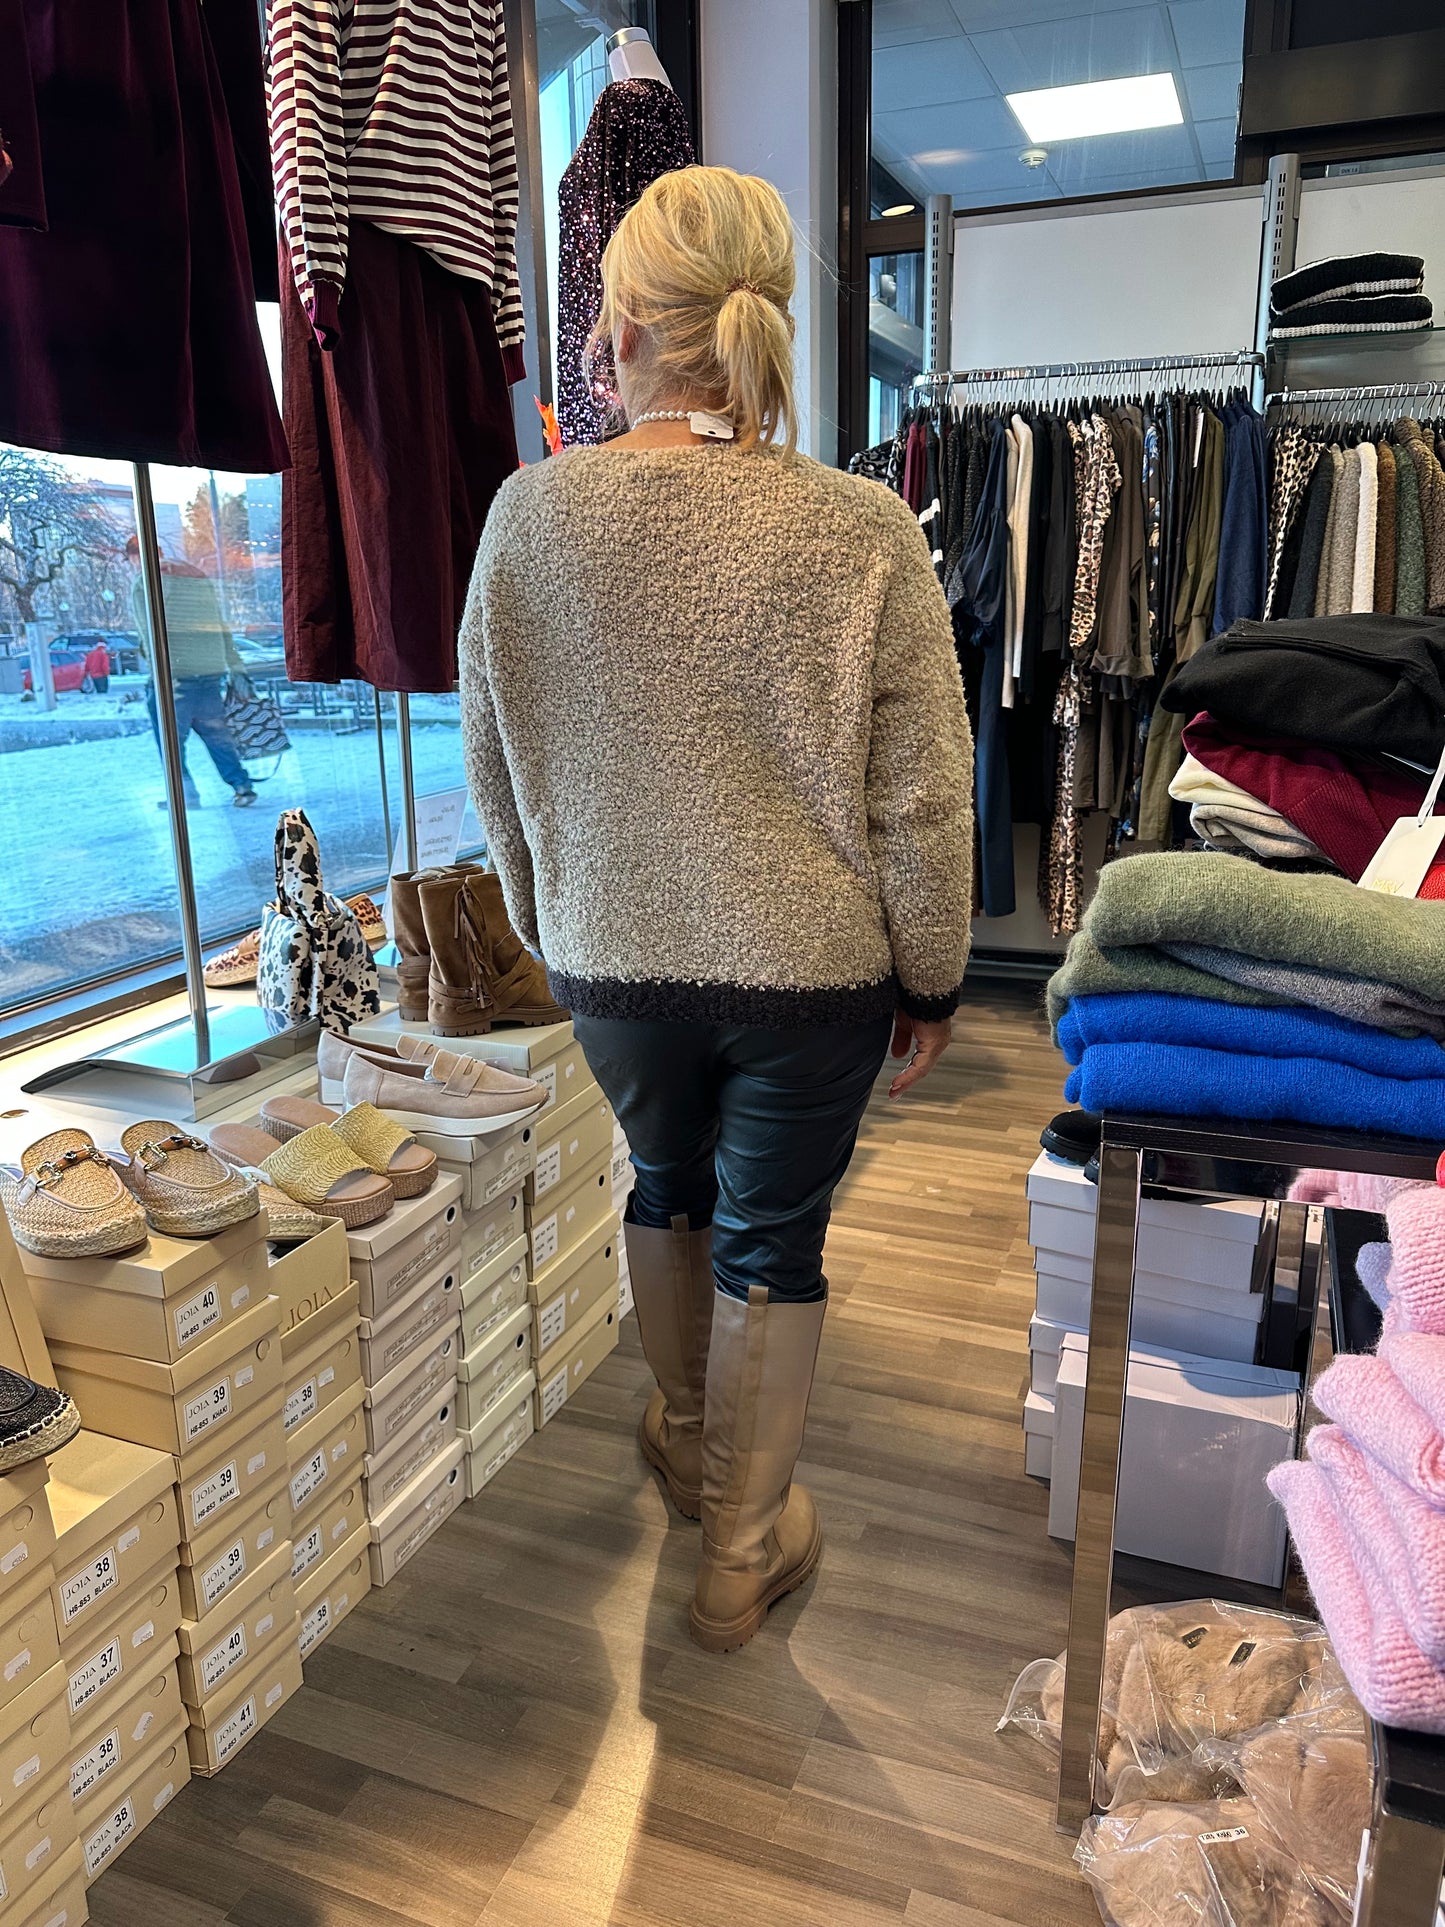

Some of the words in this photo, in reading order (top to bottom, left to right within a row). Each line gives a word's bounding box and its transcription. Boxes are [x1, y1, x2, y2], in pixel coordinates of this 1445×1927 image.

[179, 1305, 200, 1324] JOIA
[202, 1291, 214, 1308] 40
[287, 1286, 333, 1331] JOIA
[188, 1400, 210, 1419] JOIA
[213, 1386, 225, 1404] 39
[302, 1386, 312, 1402] 38
[312, 1456, 320, 1472] 37
[196, 1484, 216, 1503] JOIA
[220, 1469, 232, 1487] 39
[308, 1532, 316, 1550] 37
[66, 1576, 91, 1600] JOIA
[96, 1557, 110, 1578] 38
[206, 1566, 226, 1586] JOIA
[228, 1548, 240, 1566] 39
[94, 1576, 114, 1596] BLACK
[318, 1604, 326, 1622] 38
[206, 1650, 226, 1671] JOIA
[228, 1632, 240, 1650] 40
[72, 1667, 96, 1691] JOIA
[100, 1646, 114, 1668] 37
[100, 1664, 118, 1686] BLACK
[218, 1722, 237, 1744] JOIA
[240, 1704, 250, 1722] 41
[70, 1758, 95, 1782] JOIA
[99, 1738, 113, 1758] 38
[98, 1755, 116, 1776] BLACK
[88, 1829, 110, 1856] JOIA
[114, 1807, 128, 1828] 38
[114, 1821, 132, 1844] BLACK
